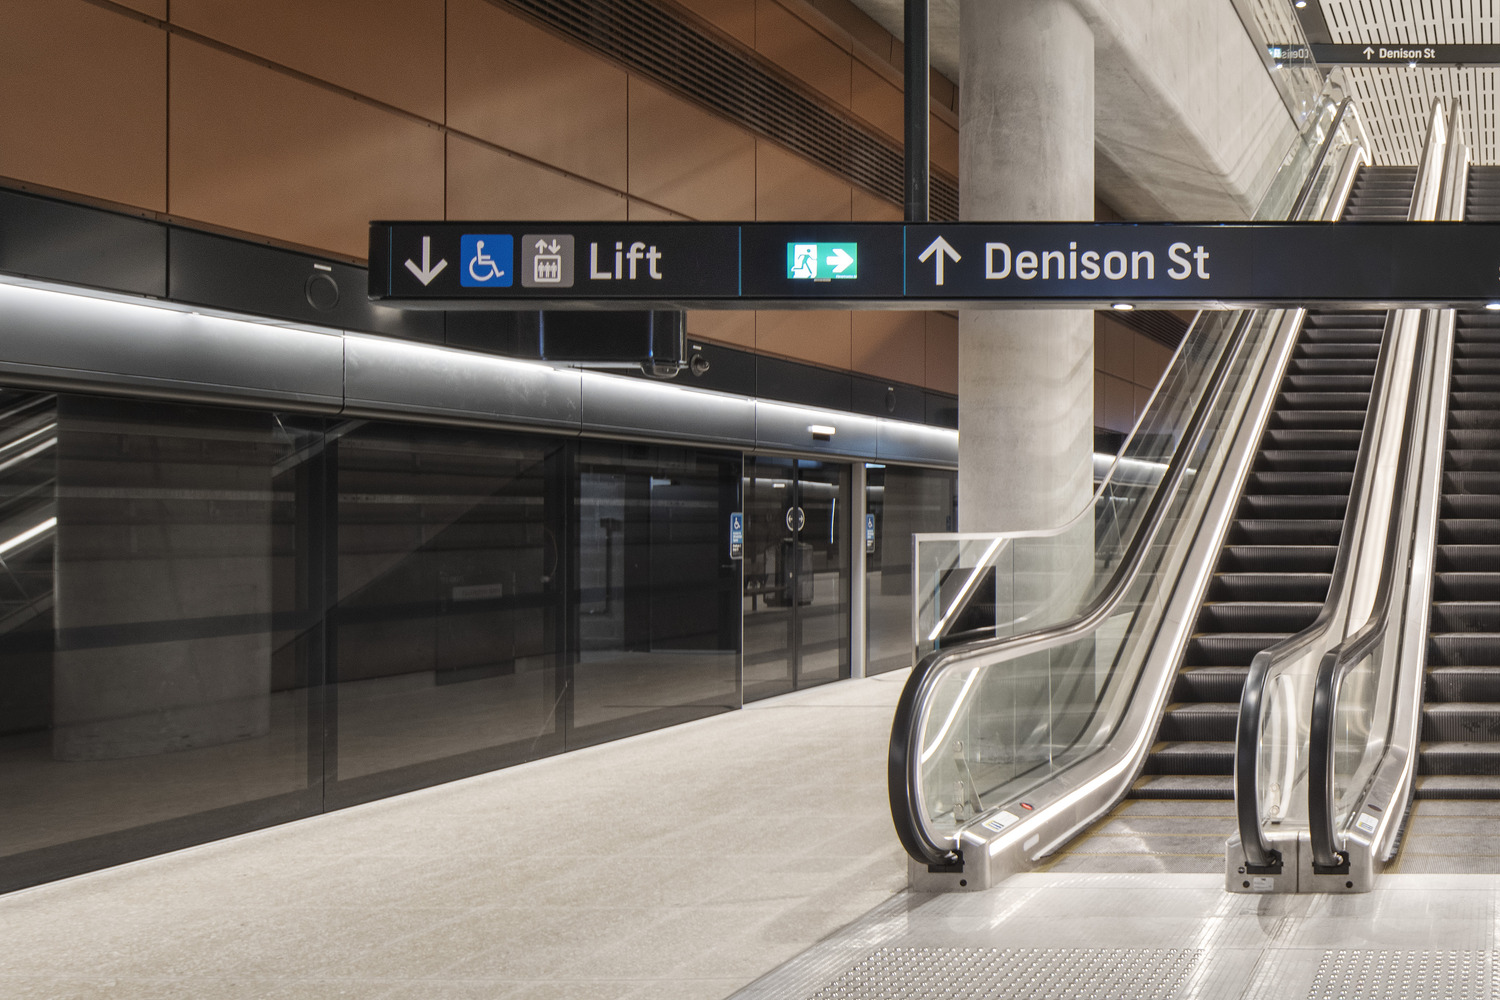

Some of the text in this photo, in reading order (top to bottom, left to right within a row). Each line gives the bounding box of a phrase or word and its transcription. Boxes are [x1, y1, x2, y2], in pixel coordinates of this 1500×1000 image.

[1379, 47, 1436, 59] Denison St
[589, 241, 663, 280] Lift
[985, 241, 1210, 281] Denison St
